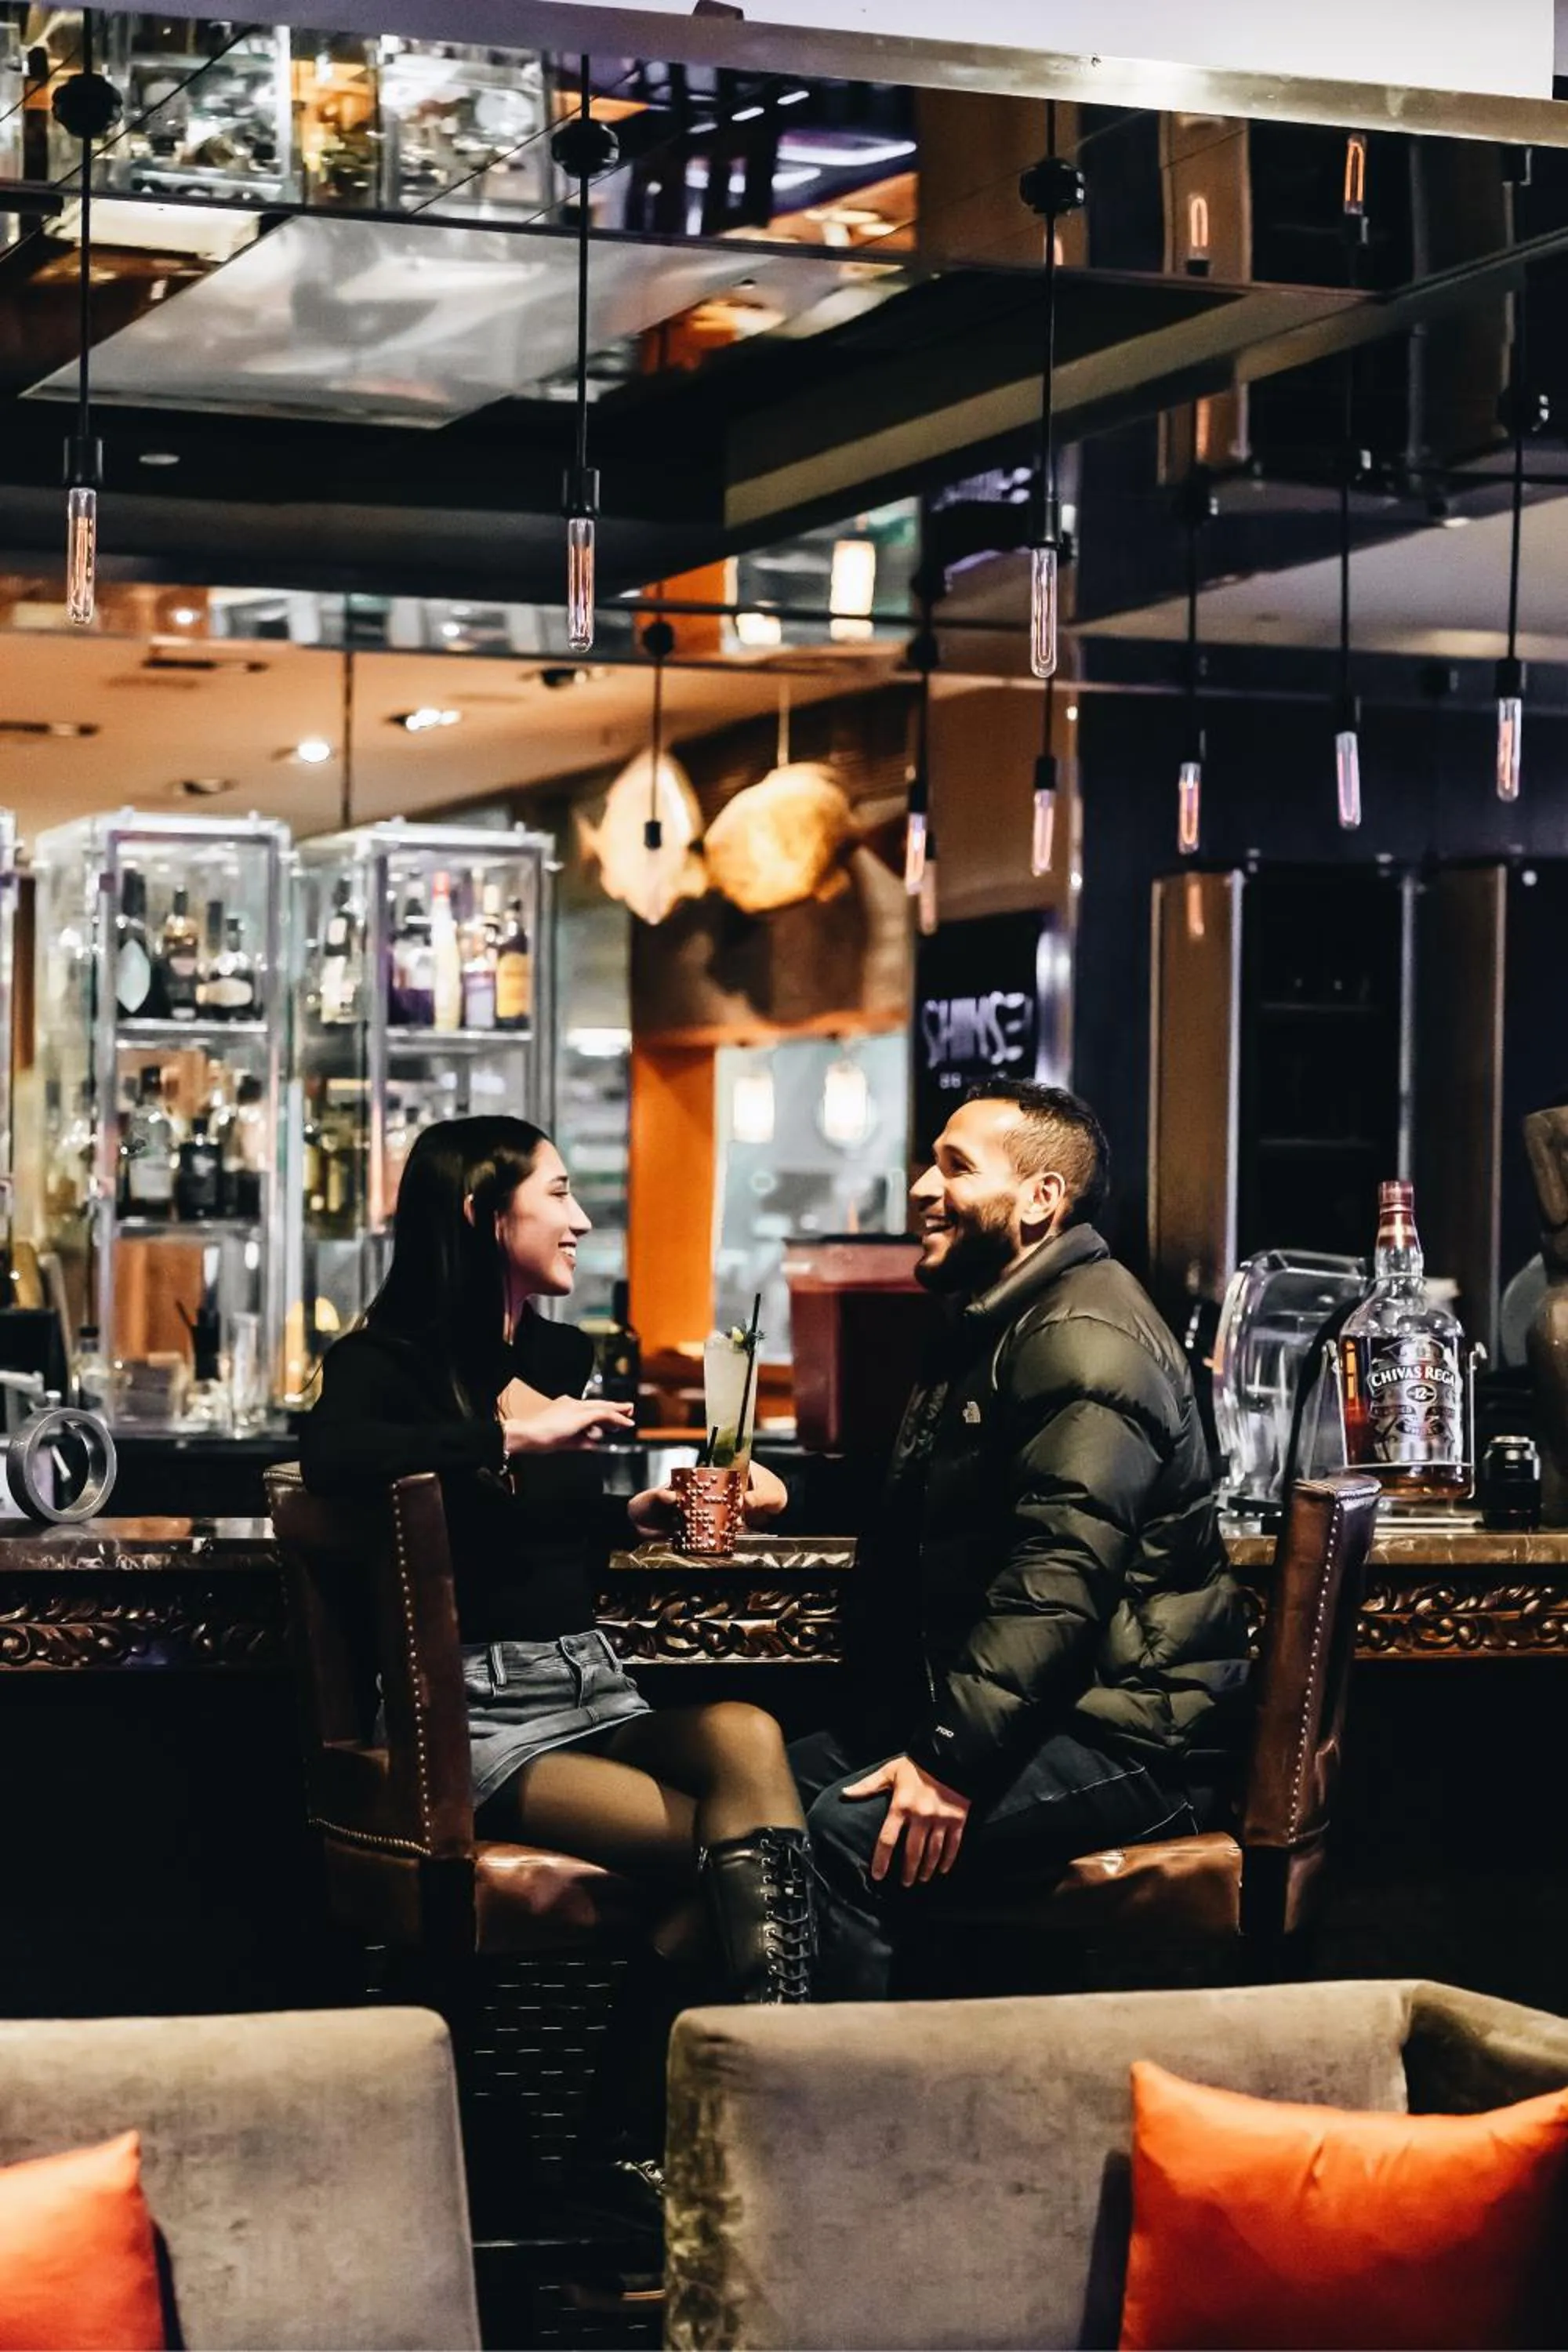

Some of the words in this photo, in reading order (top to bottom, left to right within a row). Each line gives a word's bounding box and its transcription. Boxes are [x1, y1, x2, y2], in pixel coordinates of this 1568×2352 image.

[1371, 1367, 1422, 1387] CHIVAS
[1425, 1366, 1455, 1387] REGA
[1414, 1388, 1428, 1401] 12
